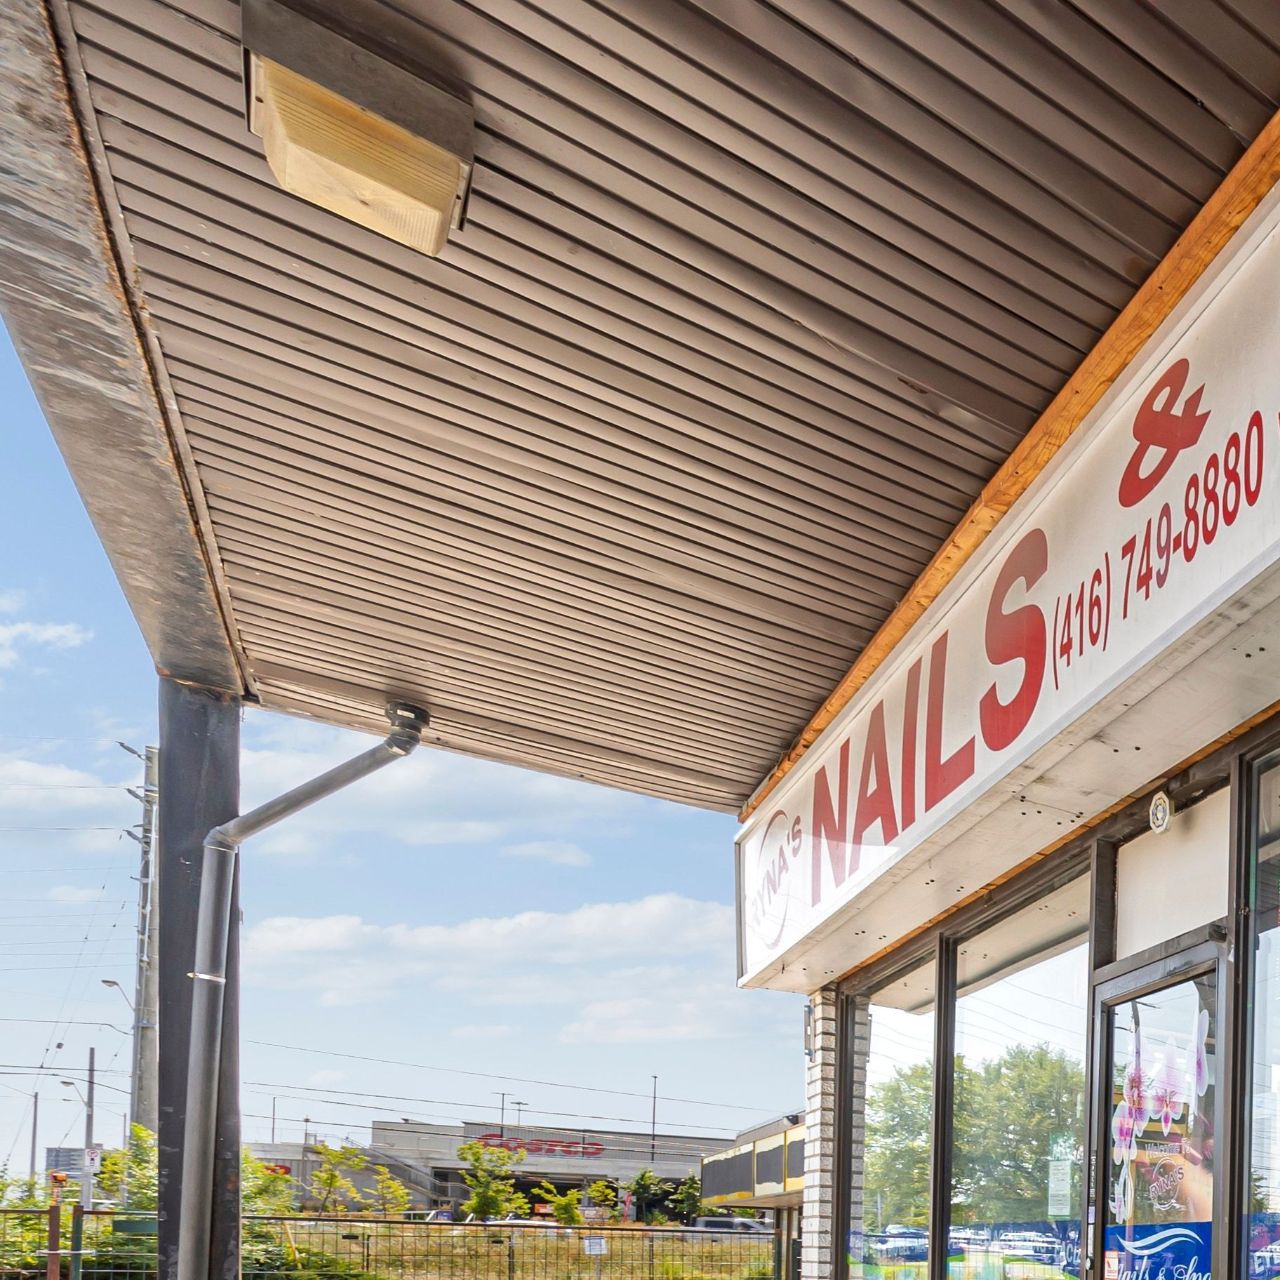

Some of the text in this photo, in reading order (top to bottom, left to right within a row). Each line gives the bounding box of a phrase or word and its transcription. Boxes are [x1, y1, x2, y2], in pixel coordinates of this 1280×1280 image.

[811, 528, 1048, 908] NAILS
[1118, 357, 1211, 508] &
[1052, 410, 1265, 690] (416) 749-8880
